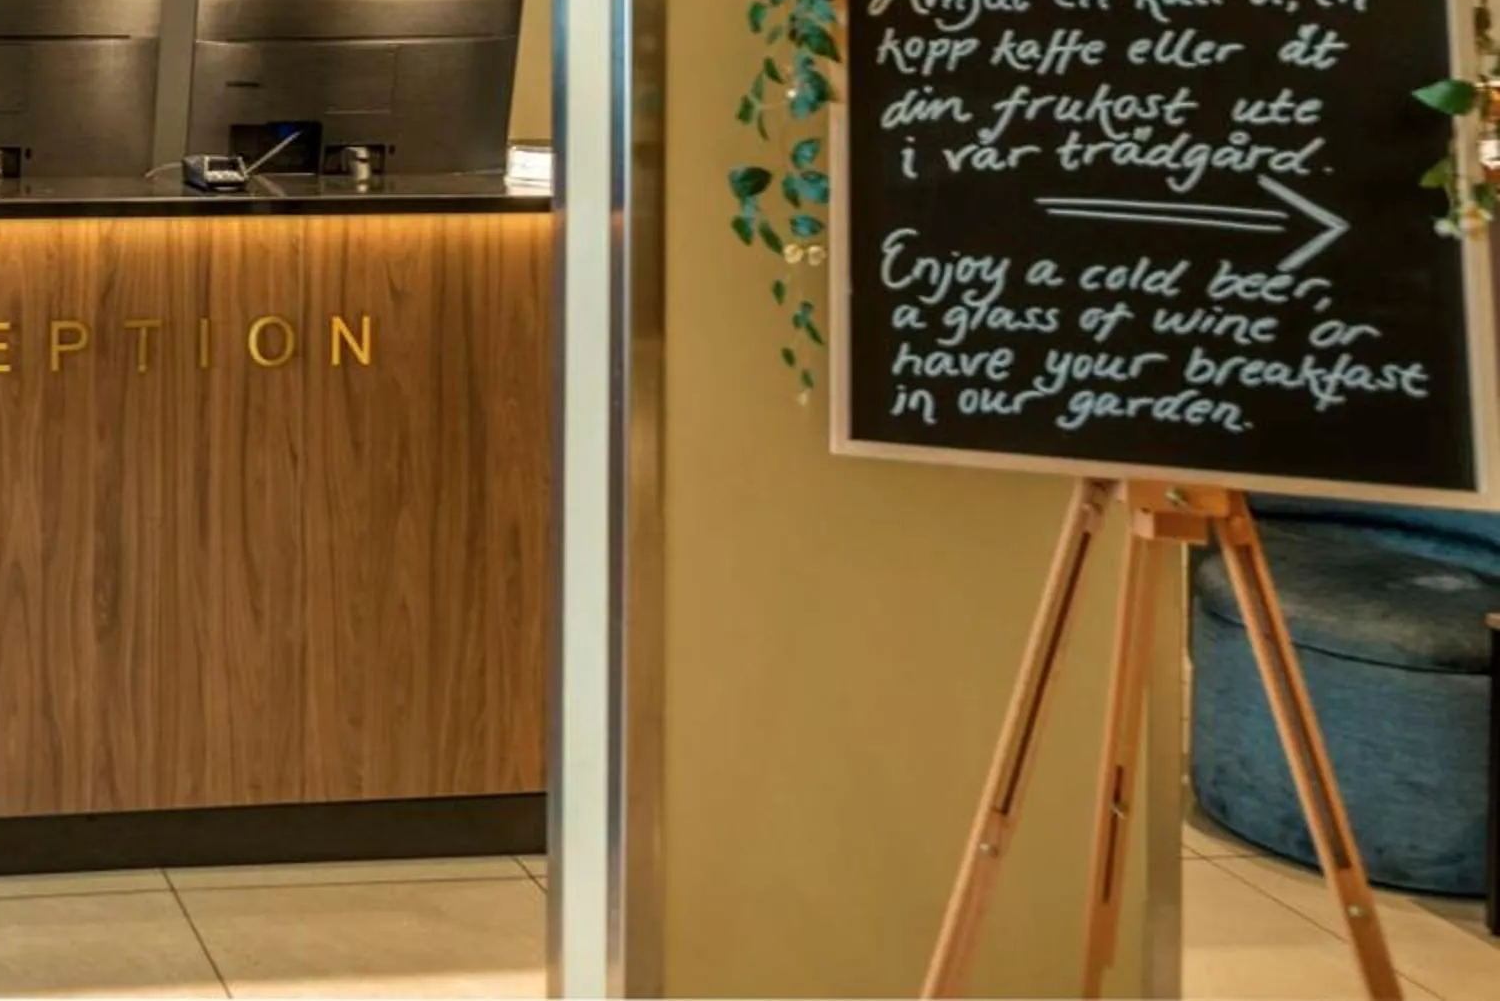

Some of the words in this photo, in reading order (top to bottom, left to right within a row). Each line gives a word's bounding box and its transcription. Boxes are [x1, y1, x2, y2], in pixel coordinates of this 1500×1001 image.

[876, 27, 980, 75] kopp
[989, 29, 1106, 75] kaffe
[1128, 28, 1245, 68] eller
[880, 85, 973, 129] din
[992, 83, 1198, 144] frukost
[1231, 88, 1322, 124] ute
[901, 135, 918, 179] i
[943, 128, 1041, 172] vår
[880, 228, 1011, 306] Enjoy
[1026, 259, 1064, 286] a
[1079, 256, 1191, 296] cold
[1207, 259, 1332, 312] beer,
[891, 304, 927, 328] a
[936, 302, 1060, 345] glass
[1079, 301, 1134, 342] of
[1153, 306, 1278, 344] wine
[1309, 320, 1382, 347] or
[891, 342, 1014, 380] have
[1033, 350, 1168, 394] your
[1184, 346, 1429, 412] breakfast
[890, 384, 936, 425] in
[957, 388, 1045, 413] our
[1056, 390, 1253, 431] garden.
